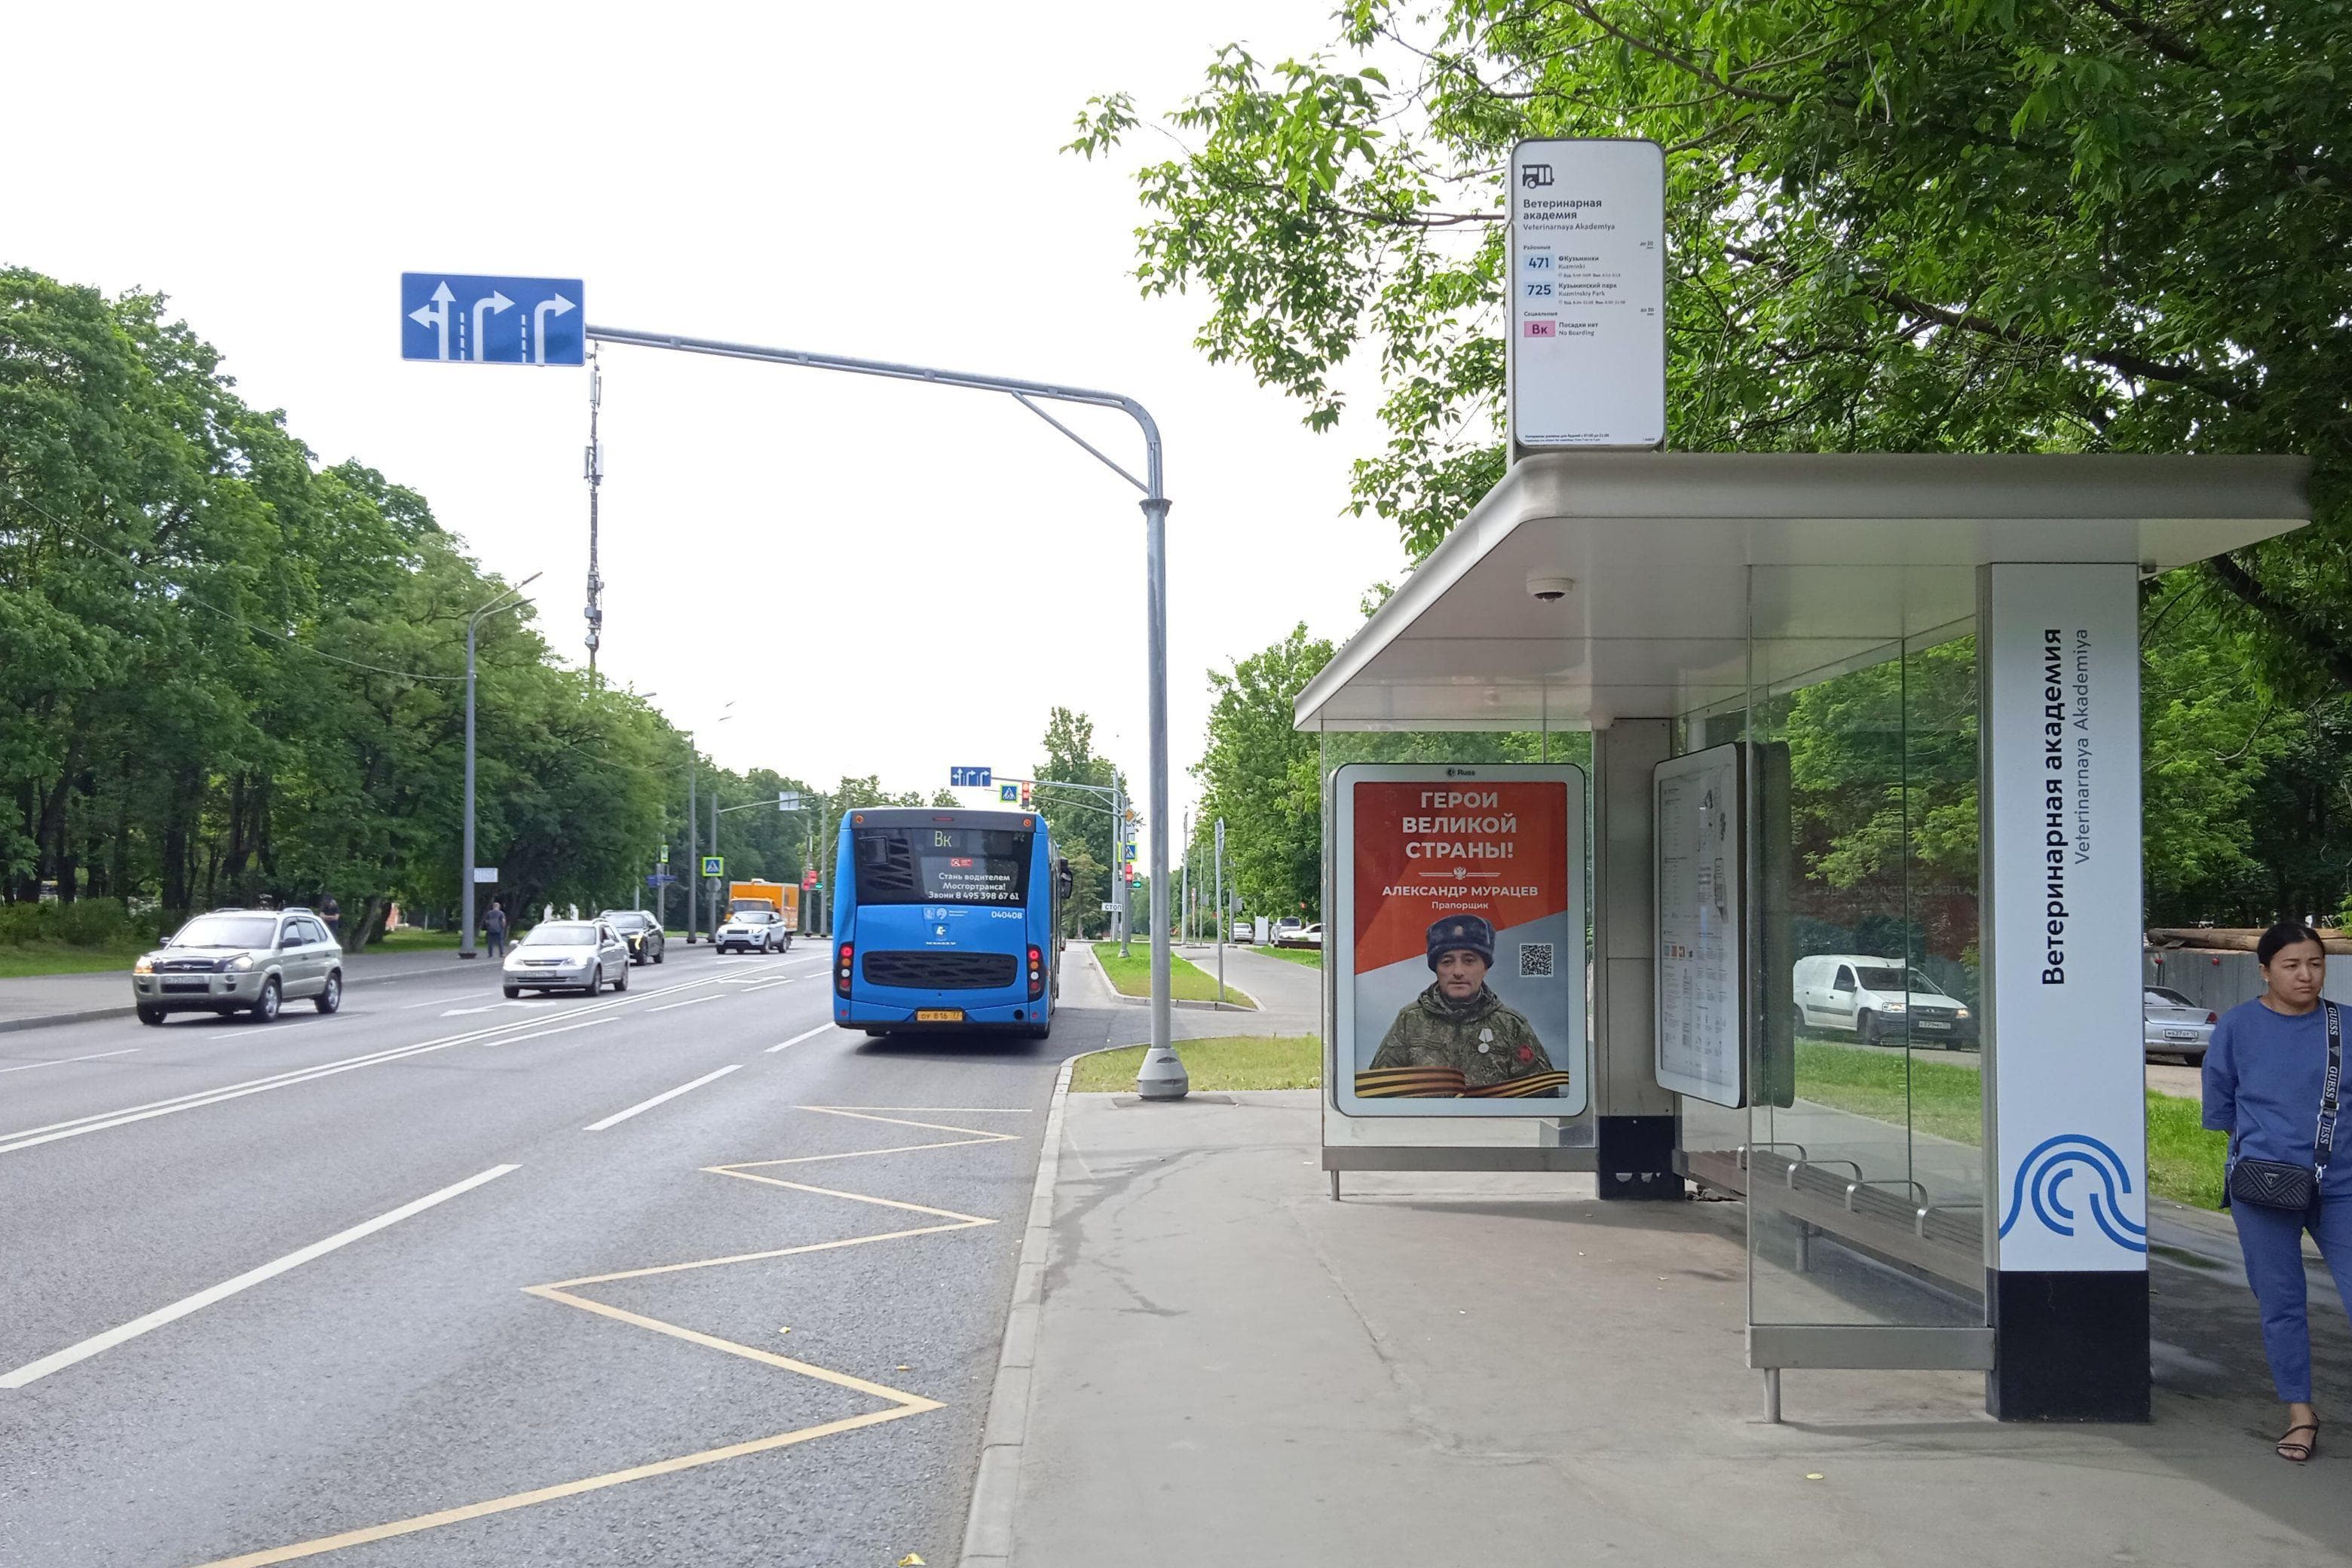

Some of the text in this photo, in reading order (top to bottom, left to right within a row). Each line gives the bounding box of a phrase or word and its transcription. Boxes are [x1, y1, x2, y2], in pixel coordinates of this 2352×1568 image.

[1524, 199, 1602, 210] Ветеринарная
[1524, 212, 1577, 221] академия
[1529, 258, 1549, 268] 471
[1527, 285, 1551, 296] 725
[1532, 324, 1548, 334] Вк
[2072, 629, 2093, 865] Veterinarnaya Akademiya
[1421, 792, 1499, 809] ГЕРОИ
[2042, 629, 2069, 985] Ветеринарная академия
[1402, 813, 1517, 834] ВЕЛИКОЙ
[935, 831, 951, 847] Вк
[1405, 841, 1514, 859] СТРАНЫ!
[939, 872, 963, 880] Стань
[942, 883, 1006, 891] Мосгортранса!
[1382, 886, 1538, 899] АЛЕКСАНДР МУРАЦЕВ
[1432, 902, 1489, 911] Прапорщик
[991, 911, 1023, 919] 040408
[2328, 1007, 2338, 1036] GUESS
[2326, 1066, 2338, 1098] GUESS
